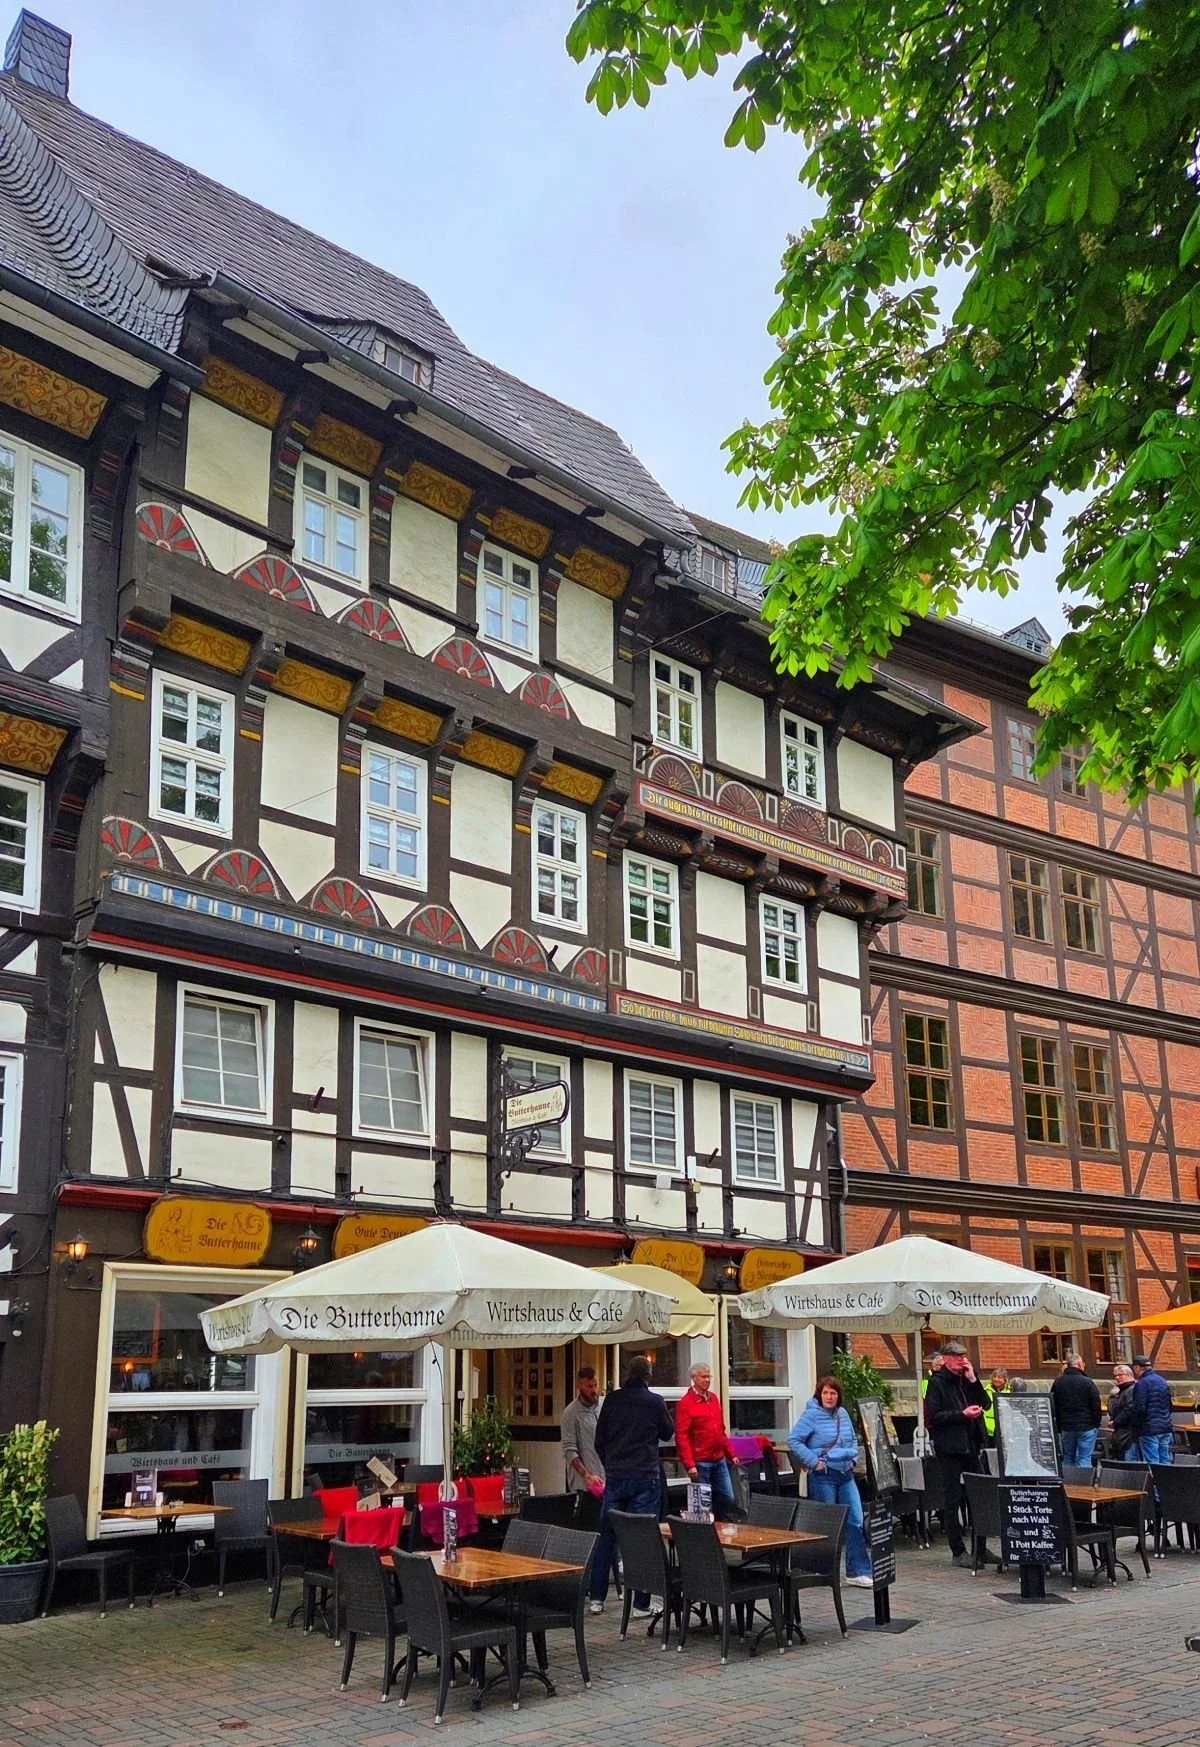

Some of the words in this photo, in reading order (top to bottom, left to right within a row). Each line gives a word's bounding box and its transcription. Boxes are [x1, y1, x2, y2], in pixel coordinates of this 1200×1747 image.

[645, 789, 661, 806] Die
[508, 1102, 550, 1117] Butterhanne
[206, 1217, 228, 1230] Die
[198, 1234, 263, 1253] Butterhanne
[784, 1294, 843, 1310] Wirtshaus
[845, 1293, 855, 1308] &
[858, 1292, 884, 1308] Café
[914, 1289, 942, 1307] Die
[947, 1289, 1038, 1309] Butterhanne
[280, 1307, 319, 1331] Die
[325, 1304, 446, 1333] Butterhanne
[486, 1301, 564, 1322] Wirtshaus
[568, 1302, 583, 1322] &
[587, 1301, 623, 1322] Café
[131, 1458, 179, 1467] Wirtshaus
[182, 1456, 198, 1465] und
[201, 1454, 221, 1464] Café
[328, 1448, 342, 1458] Die
[1013, 1505, 1032, 1513] Stück
[1024, 1528, 1039, 1536] und
